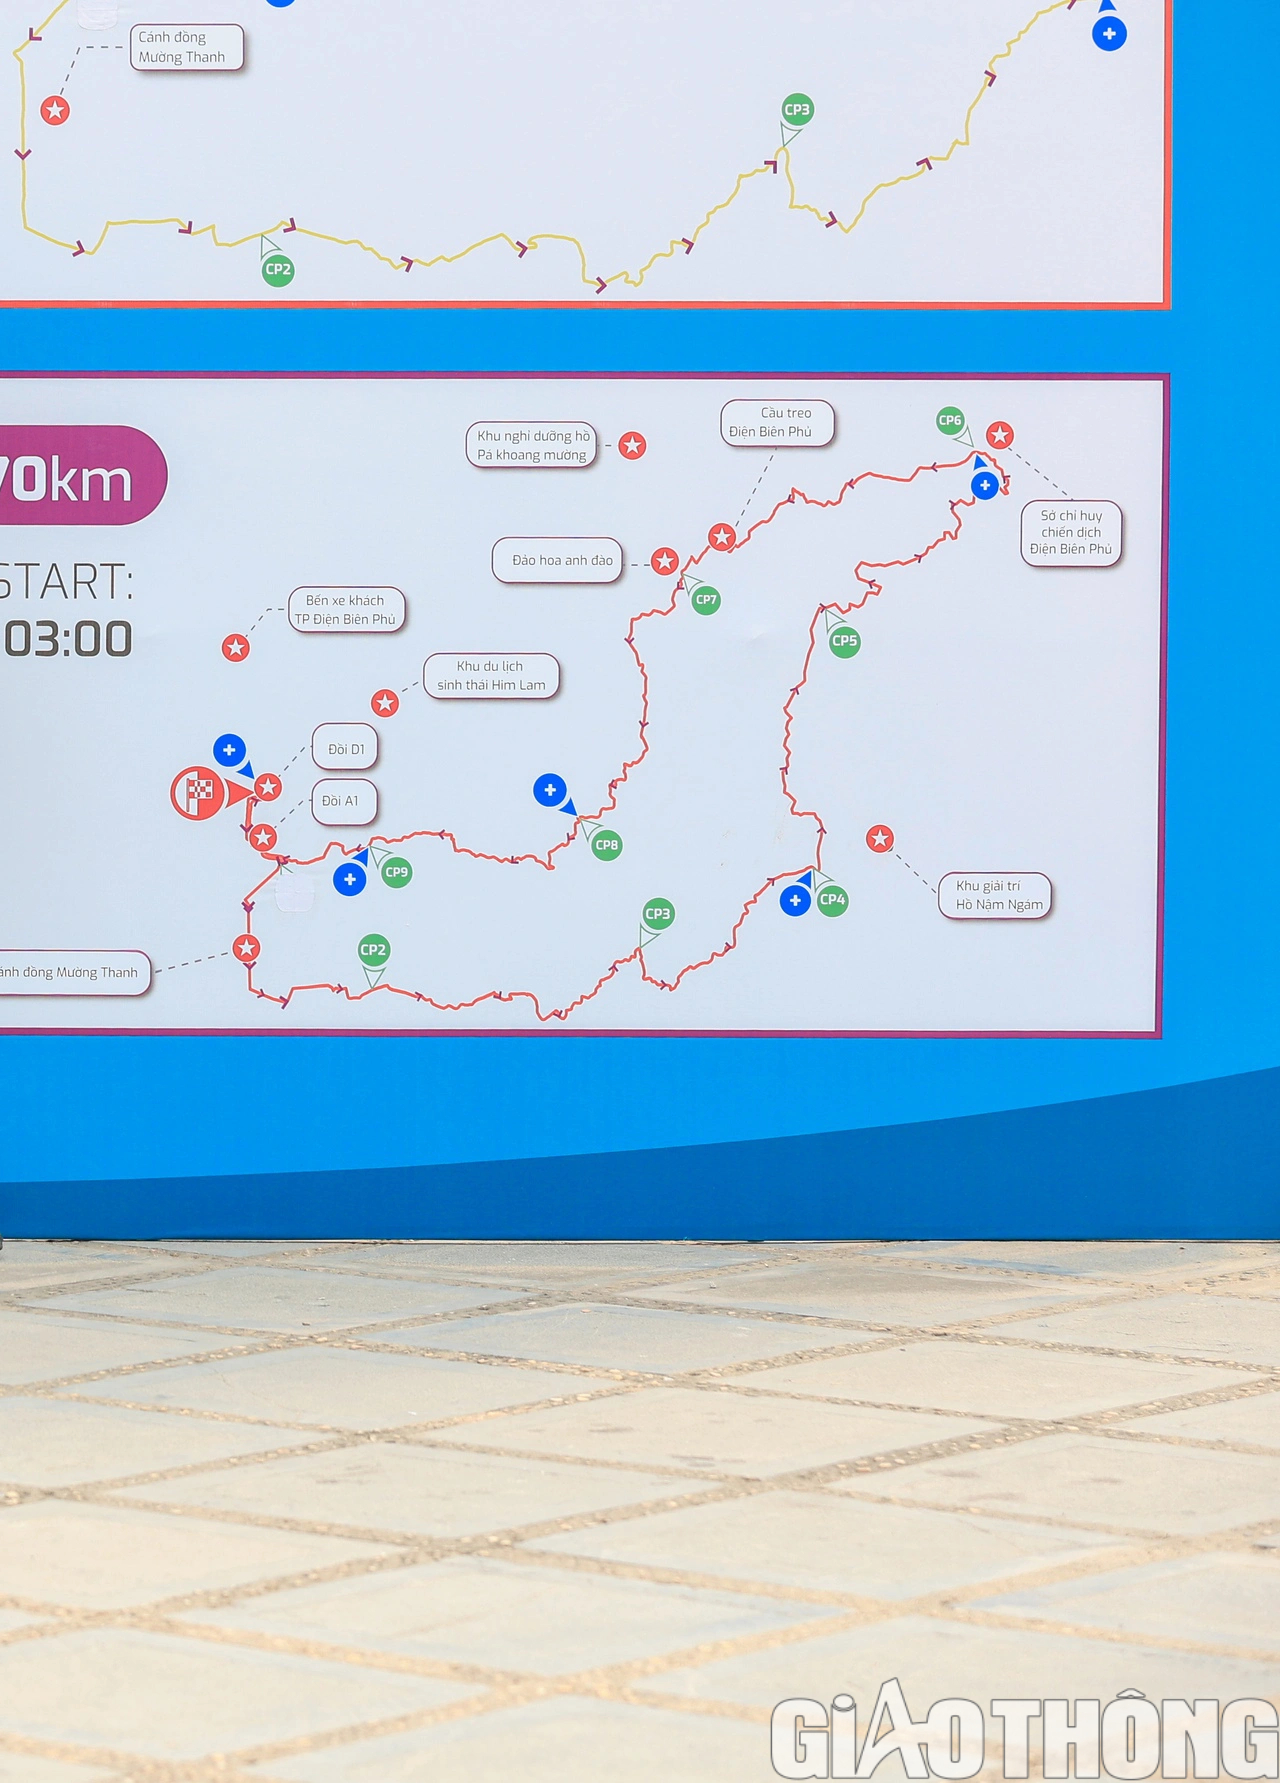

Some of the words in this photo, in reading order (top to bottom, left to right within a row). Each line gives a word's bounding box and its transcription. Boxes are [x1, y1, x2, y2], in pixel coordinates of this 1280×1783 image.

[137, 29, 170, 44] Cánh
[174, 28, 207, 47] đồng
[138, 48, 183, 66] Mường
[186, 49, 225, 63] Thanh
[783, 103, 811, 117] CP3
[265, 262, 292, 277] CP2
[761, 406, 783, 418] Cầu
[787, 407, 812, 418] treo
[938, 414, 962, 426] CP6
[477, 430, 501, 441] Khu
[504, 429, 530, 445] nghỉ
[533, 430, 572, 445] dưỡng
[575, 429, 591, 442] hồ
[729, 425, 756, 440] Điện
[759, 425, 785, 437] Biên
[788, 425, 812, 437] Phủ
[477, 448, 493, 460] Pá
[496, 449, 540, 464] khoang
[543, 448, 587, 464] mường
[1040, 509, 1057, 521] Sở
[1059, 509, 1077, 521] chỉ
[1080, 509, 1103, 524] huy
[1041, 525, 1074, 538] chiến
[1076, 526, 1102, 540] dịch
[1030, 542, 1057, 557] Điện
[1060, 542, 1086, 555] Biên
[1089, 542, 1112, 555] Phủ
[512, 553, 536, 567] Đảo
[539, 555, 562, 566] hoa
[565, 555, 587, 566] anh
[590, 553, 614, 567] đào
[306, 593, 329, 606] Bến
[332, 597, 346, 606] xe
[349, 594, 385, 606] khách
[695, 593, 717, 605] CP7
[295, 613, 310, 625] TP
[313, 613, 340, 628] Điện
[343, 613, 369, 625] Biên
[372, 613, 396, 625] Phủ
[3, 619, 134, 658] 03:00
[832, 634, 858, 647] CP5
[456, 660, 479, 672] Khu
[483, 660, 499, 672] du
[502, 660, 523, 674] lịch
[437, 679, 462, 691] sinh
[466, 679, 487, 691] thái
[492, 679, 514, 691] Him
[518, 679, 546, 691] Lam
[327, 741, 349, 756] Đồi
[351, 743, 365, 756] D1
[321, 793, 343, 808] Đồi
[345, 794, 359, 808] A1
[595, 839, 619, 851] CP8
[385, 866, 408, 878] CP9
[956, 879, 980, 891] Khu
[983, 879, 1004, 894] giải
[1007, 879, 1021, 891] trí
[819, 893, 846, 907] CP4
[956, 898, 973, 910] Hồ
[976, 898, 1004, 912] Nậm
[1008, 898, 1044, 913] Ngám
[644, 907, 671, 920] CP3
[359, 942, 386, 957] CP2
[23, 965, 53, 982] đồng
[56, 964, 98, 982] Mường
[101, 965, 138, 979] Thanh
